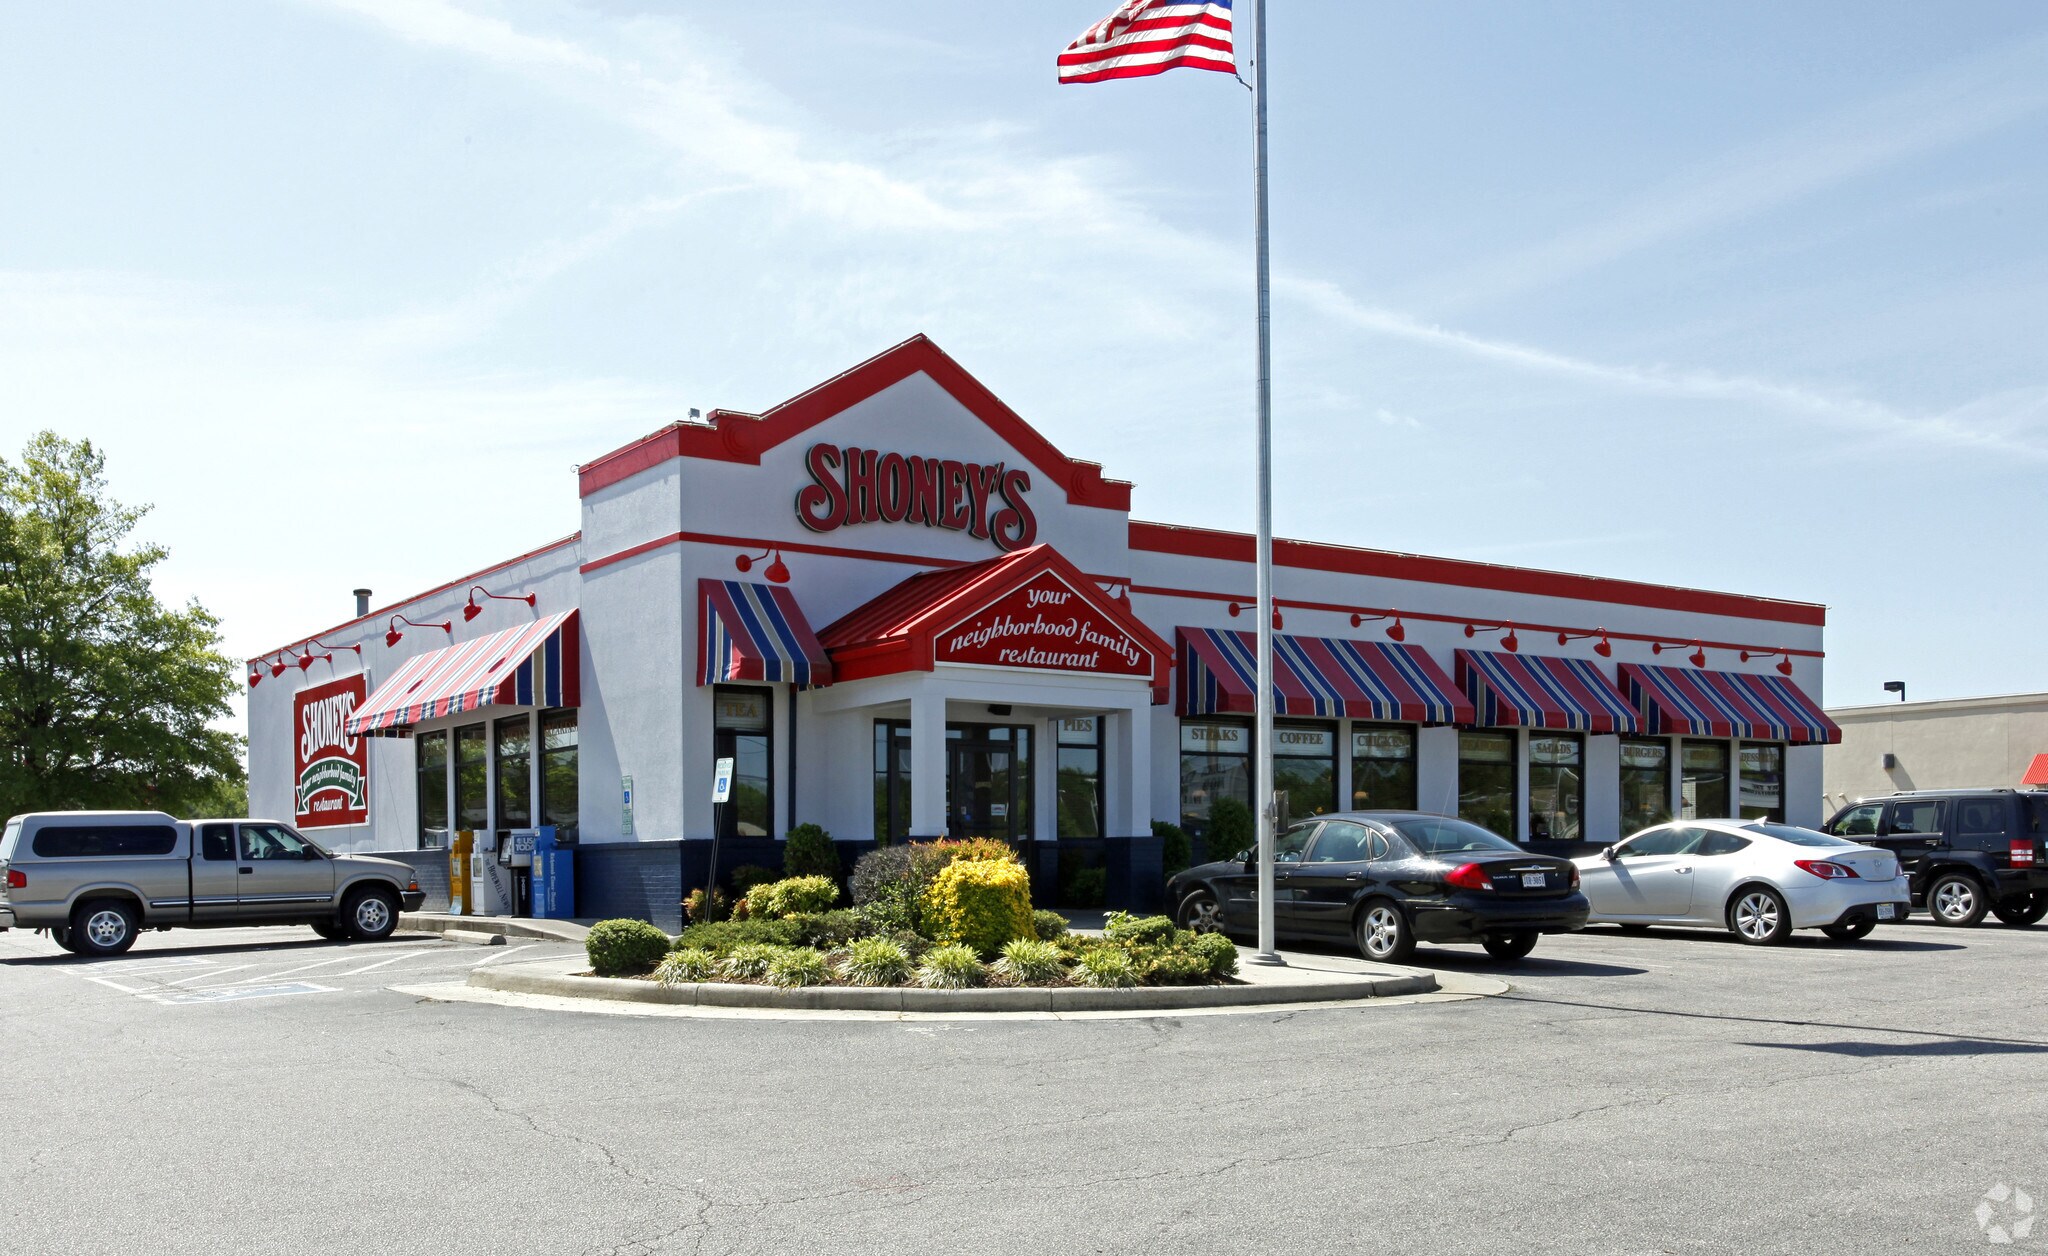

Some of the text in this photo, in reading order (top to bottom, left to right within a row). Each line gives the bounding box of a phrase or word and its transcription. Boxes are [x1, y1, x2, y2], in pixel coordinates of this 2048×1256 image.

[796, 443, 1037, 552] SHONEY'S
[1026, 588, 1071, 608] your
[950, 614, 1140, 666] neighborhood family
[998, 646, 1100, 668] restaurant
[725, 703, 758, 718] TEA
[301, 691, 358, 763] SHONEY'S
[1063, 719, 1093, 732] PIES
[1191, 728, 1239, 742] STEAKS
[1279, 732, 1324, 745] COFFEE
[1623, 746, 1663, 758] BURGERS
[313, 795, 343, 812] restaurant
[515, 844, 535, 852] TODA
